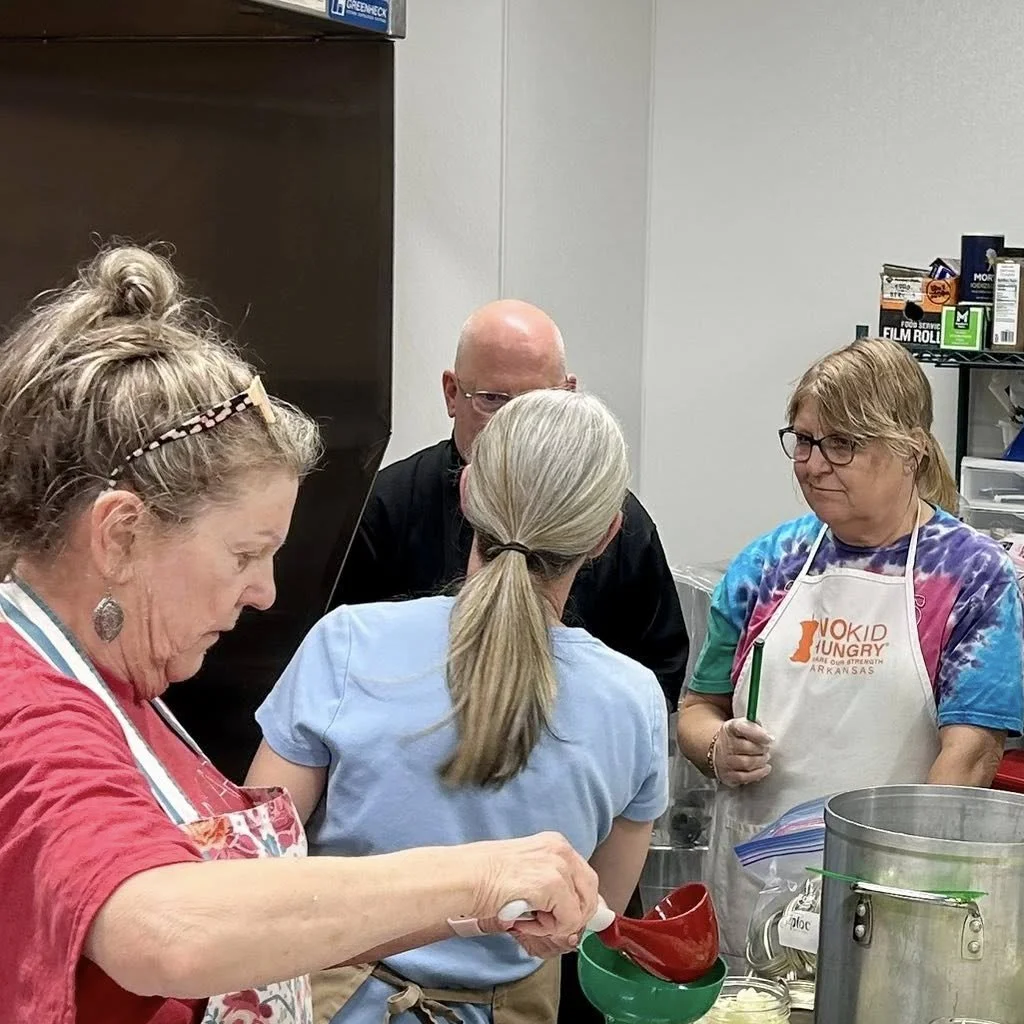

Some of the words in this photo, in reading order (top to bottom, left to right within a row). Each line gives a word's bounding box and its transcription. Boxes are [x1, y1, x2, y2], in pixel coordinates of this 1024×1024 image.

[346, 0, 387, 18] GREENHECK
[900, 320, 918, 329] FOOD
[918, 322, 941, 330] SERVIC
[883, 326, 912, 341] FILM
[809, 665, 875, 675] ARKANSAS
